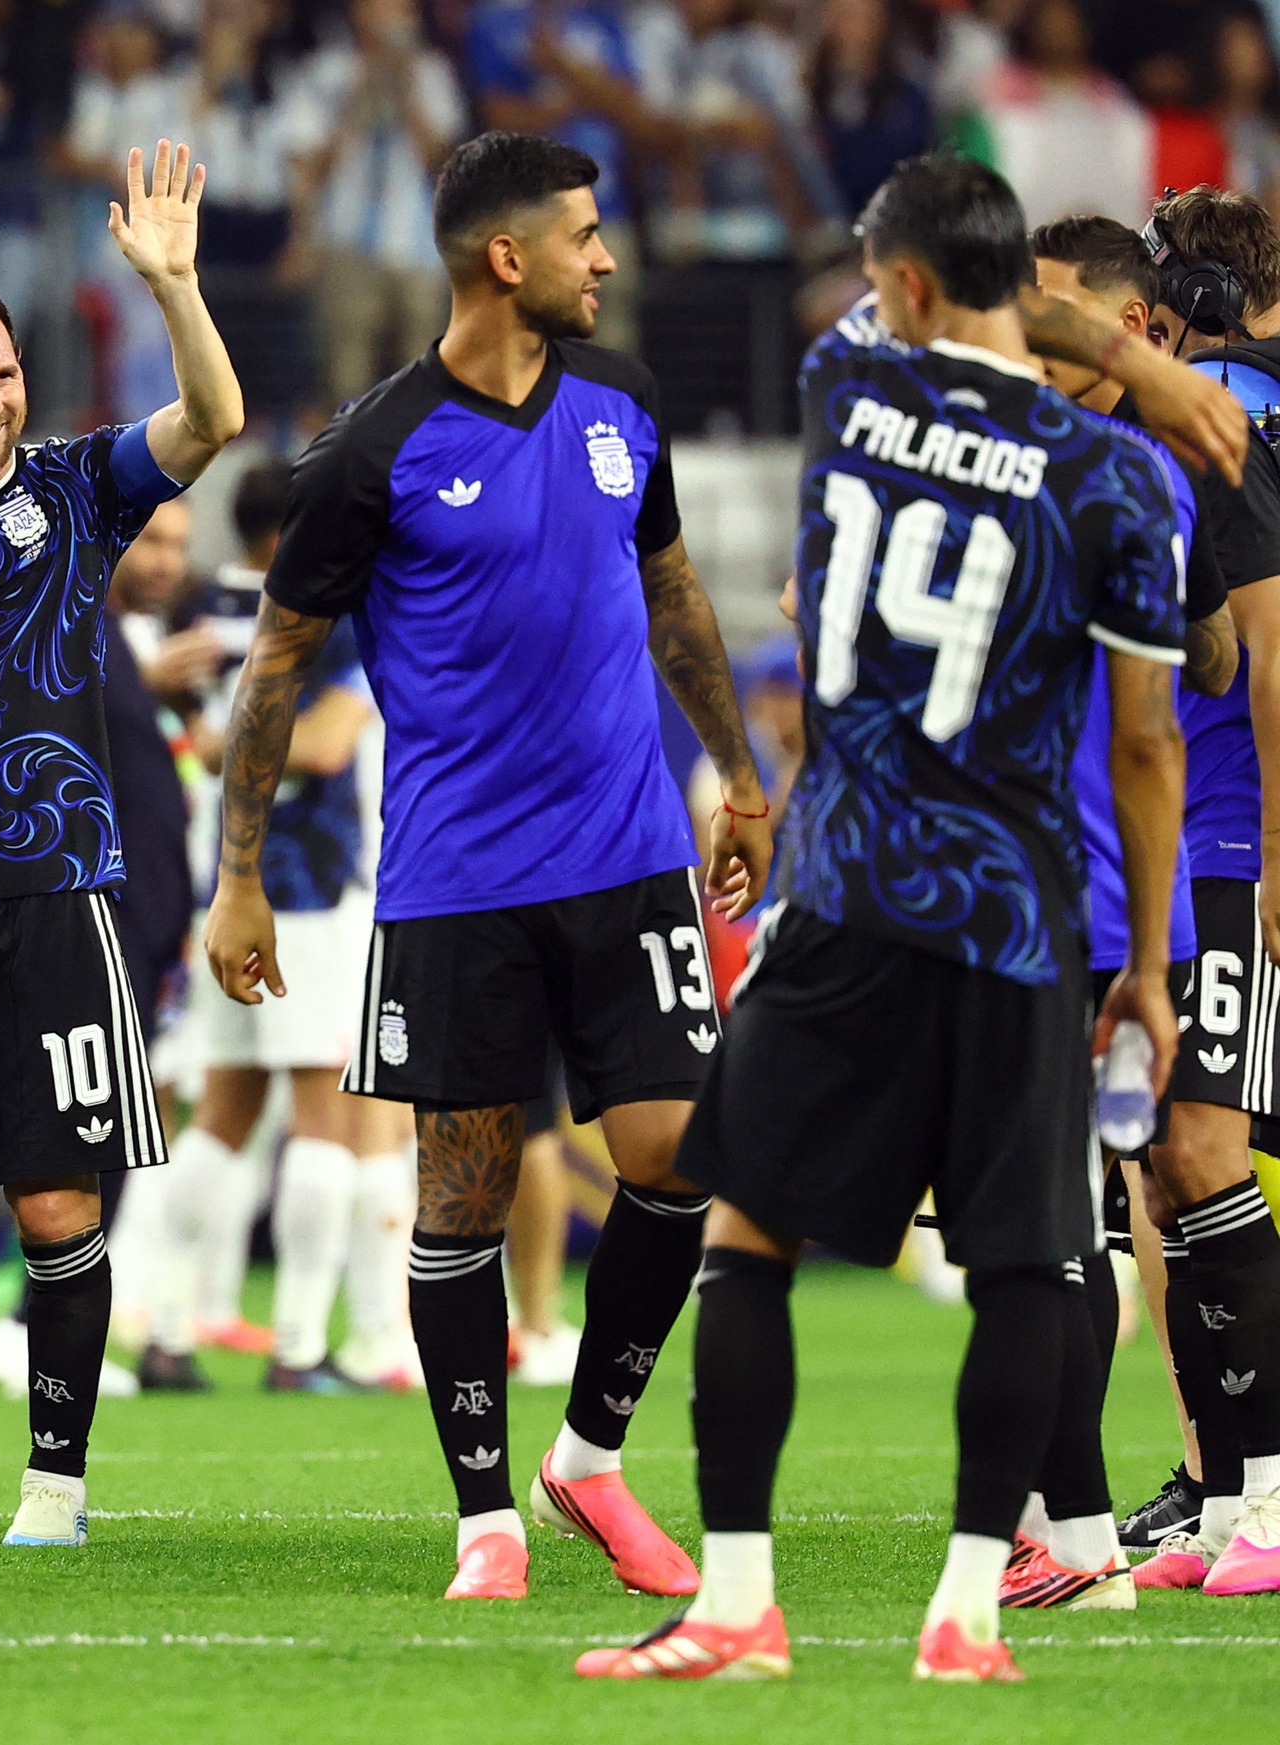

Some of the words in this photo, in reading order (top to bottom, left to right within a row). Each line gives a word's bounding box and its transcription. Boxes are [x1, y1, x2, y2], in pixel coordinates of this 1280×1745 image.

[839, 396, 1049, 501] PALACIOS
[815, 470, 1017, 743] 14
[639, 925, 714, 1014] 13
[1178, 949, 1244, 1036] 6
[41, 1023, 113, 1112] 10
